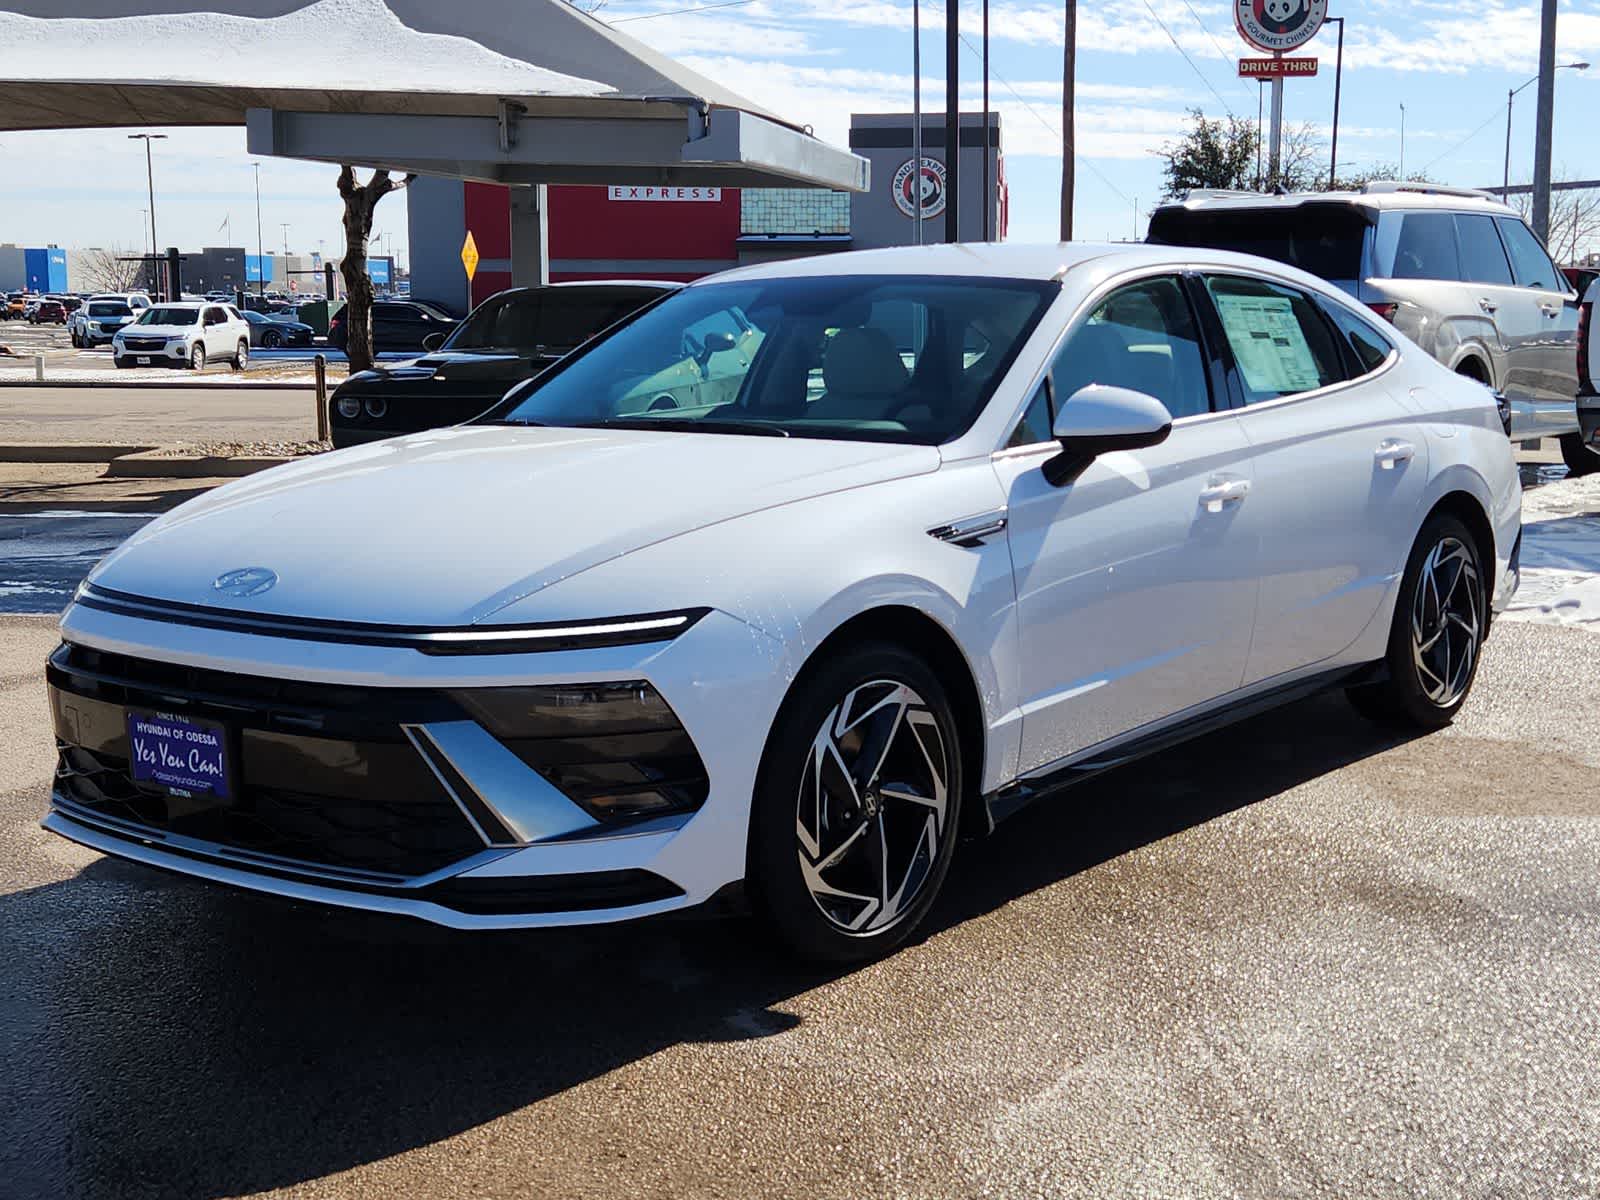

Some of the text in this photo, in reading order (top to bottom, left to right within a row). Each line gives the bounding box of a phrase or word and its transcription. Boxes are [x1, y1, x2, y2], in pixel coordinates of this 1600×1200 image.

[1247, 21, 1317, 45] GOURMET CHINESE
[1240, 61, 1317, 72] DRIVE THRU
[614, 187, 715, 198] EXPRESS
[136, 722, 218, 747] HYUNDAI OF ODESSA
[134, 738, 223, 777] Yes You Can!
